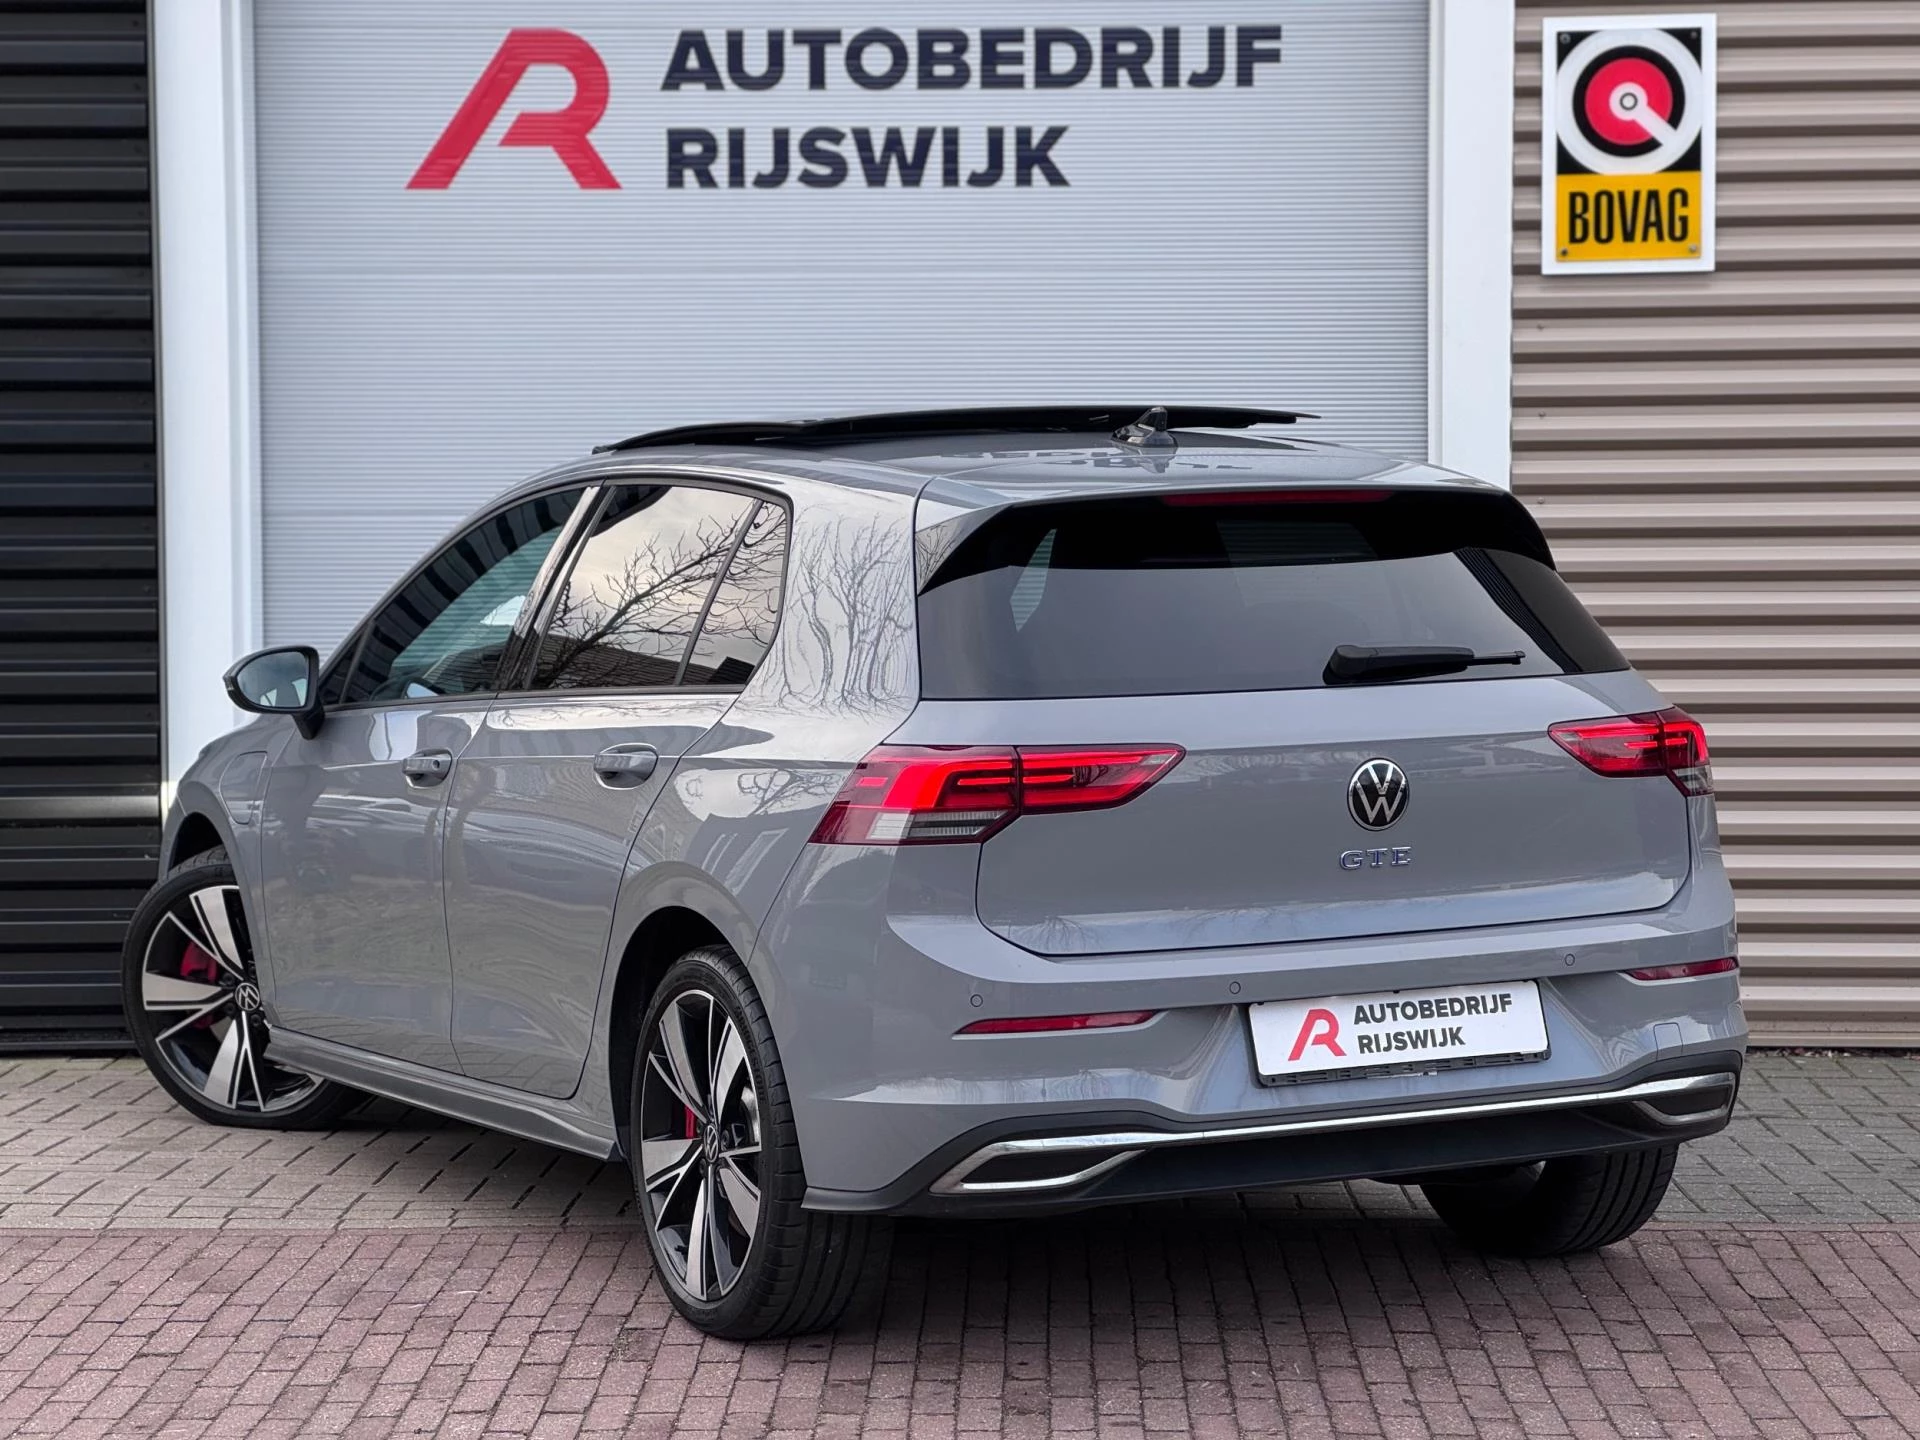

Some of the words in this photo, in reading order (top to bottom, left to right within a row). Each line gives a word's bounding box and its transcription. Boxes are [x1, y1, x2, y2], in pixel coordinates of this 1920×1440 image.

[661, 26, 1282, 91] AUTOBEDRIJF
[666, 126, 1070, 189] RIJSWIJK
[1568, 188, 1689, 244] BOVAG
[1339, 846, 1412, 870] GTE
[1353, 993, 1513, 1025] AUTOBEDRIJF
[1357, 1027, 1466, 1054] RIJSWIJK
